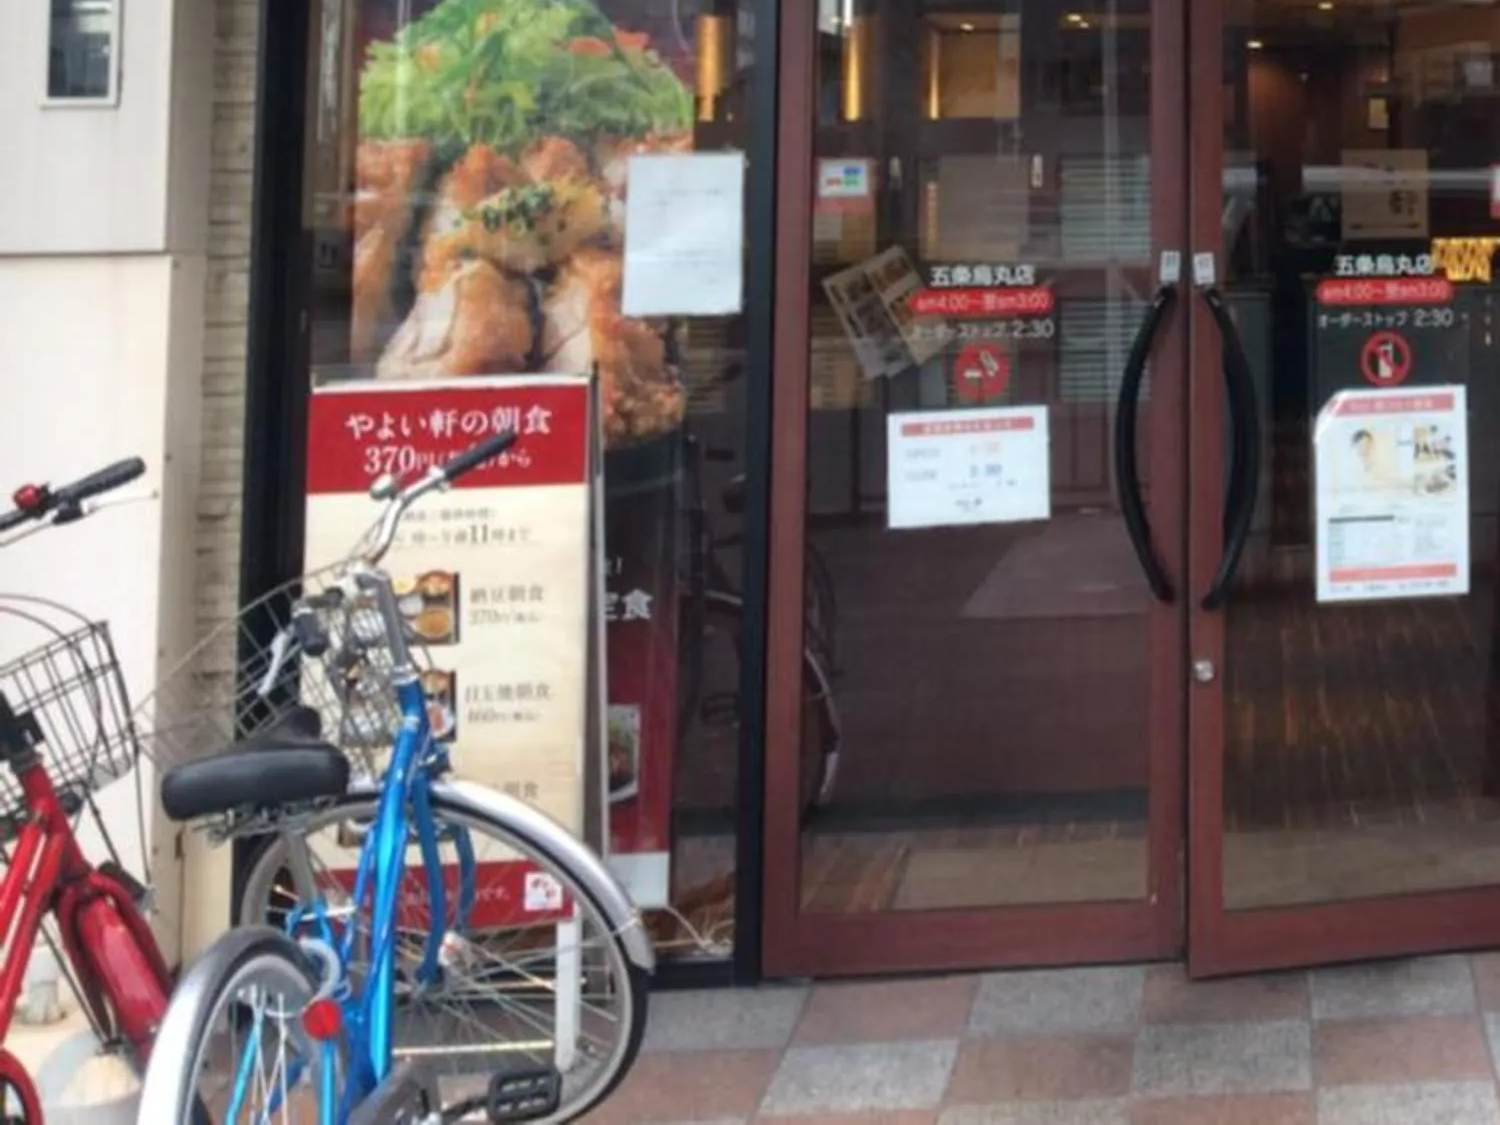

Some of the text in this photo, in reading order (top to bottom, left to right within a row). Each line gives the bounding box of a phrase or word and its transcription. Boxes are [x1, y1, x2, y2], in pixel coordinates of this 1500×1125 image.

[345, 403, 553, 441] やよい軒の朝食
